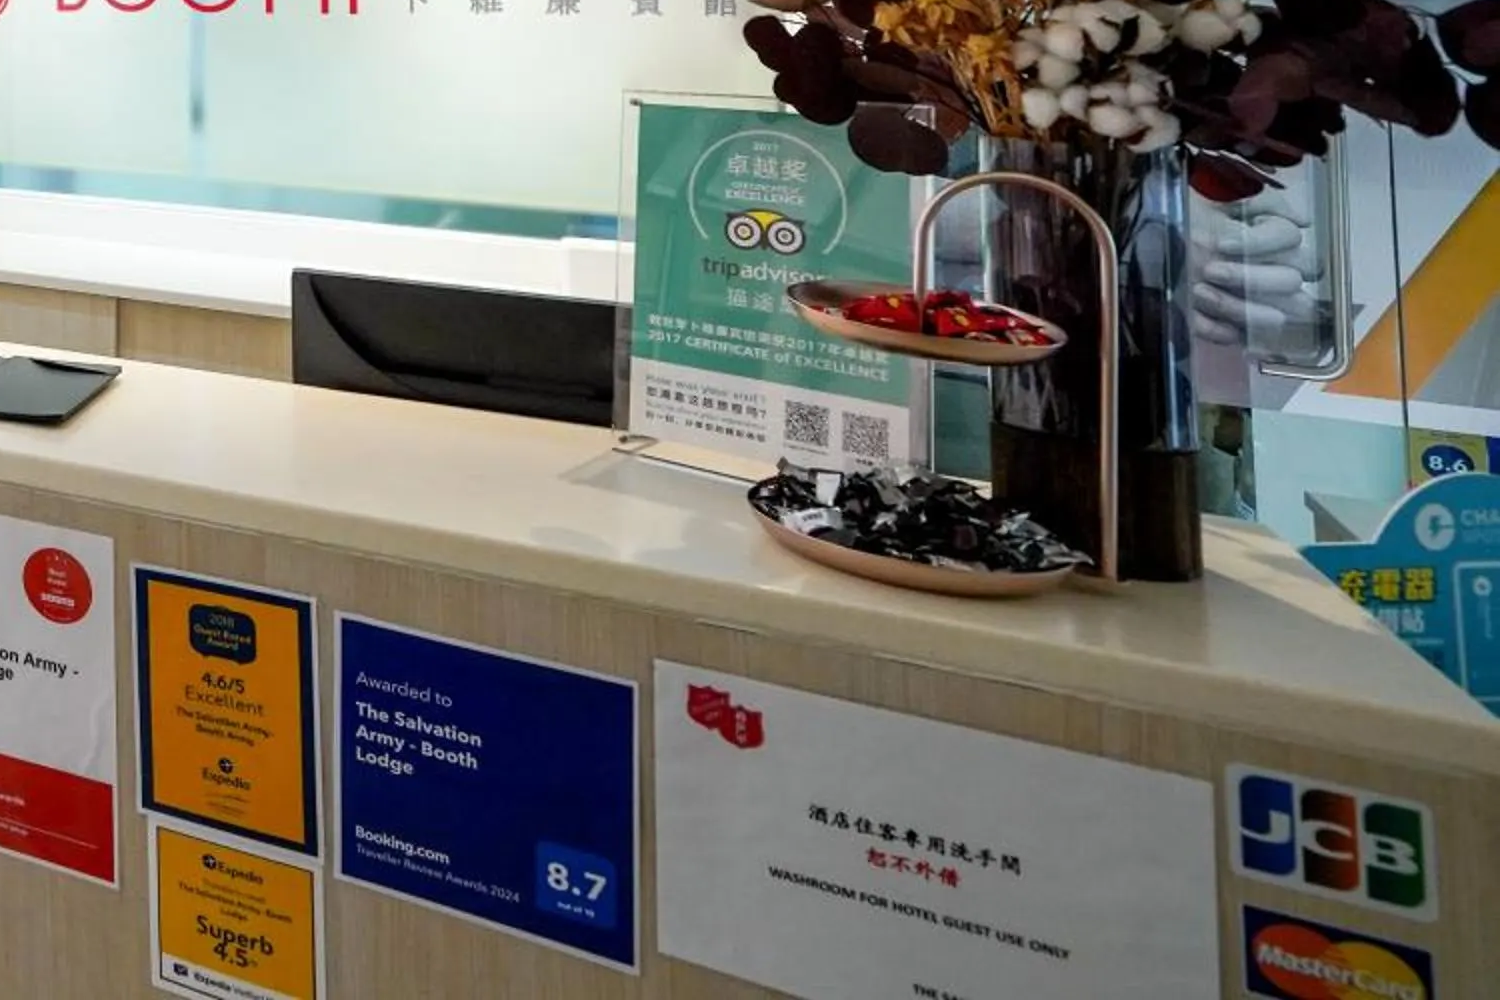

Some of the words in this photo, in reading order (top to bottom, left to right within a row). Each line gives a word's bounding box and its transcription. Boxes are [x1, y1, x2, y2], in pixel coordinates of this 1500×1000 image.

[649, 329, 680, 345] 2017
[684, 335, 769, 362] CERTIFICATE
[774, 351, 790, 365] of
[795, 355, 890, 383] EXCELLENCE
[23, 652, 68, 680] Army
[202, 672, 245, 694] 4.6/5
[185, 685, 265, 717] Excellent
[356, 671, 431, 703] Awarded
[435, 690, 453, 707] to
[356, 701, 390, 723] The
[394, 711, 483, 748] Salvation
[356, 725, 405, 751] Army
[421, 741, 479, 771] Booth
[356, 747, 415, 776] Lodge
[201, 766, 252, 791] Expedia
[355, 824, 450, 865] Booking.com
[808, 803, 1022, 877] 酒店住客專用洗手間
[1240, 809, 1420, 876] JCB
[403, 858, 443, 880] Review
[445, 871, 488, 895] Awards
[489, 885, 520, 903] 2024
[546, 862, 607, 902] 8.7
[768, 865, 858, 901] WASHROOM
[859, 892, 889, 909] FOR
[891, 902, 938, 925] HOTEL
[942, 914, 992, 938] GUEST
[995, 929, 1025, 949] USE
[1029, 940, 1071, 960] ONLY
[196, 915, 274, 956] Superb
[213, 943, 249, 969] 4.5
[912, 983, 938, 1000] THE
[1257, 943, 1422, 1000] MasterCard
